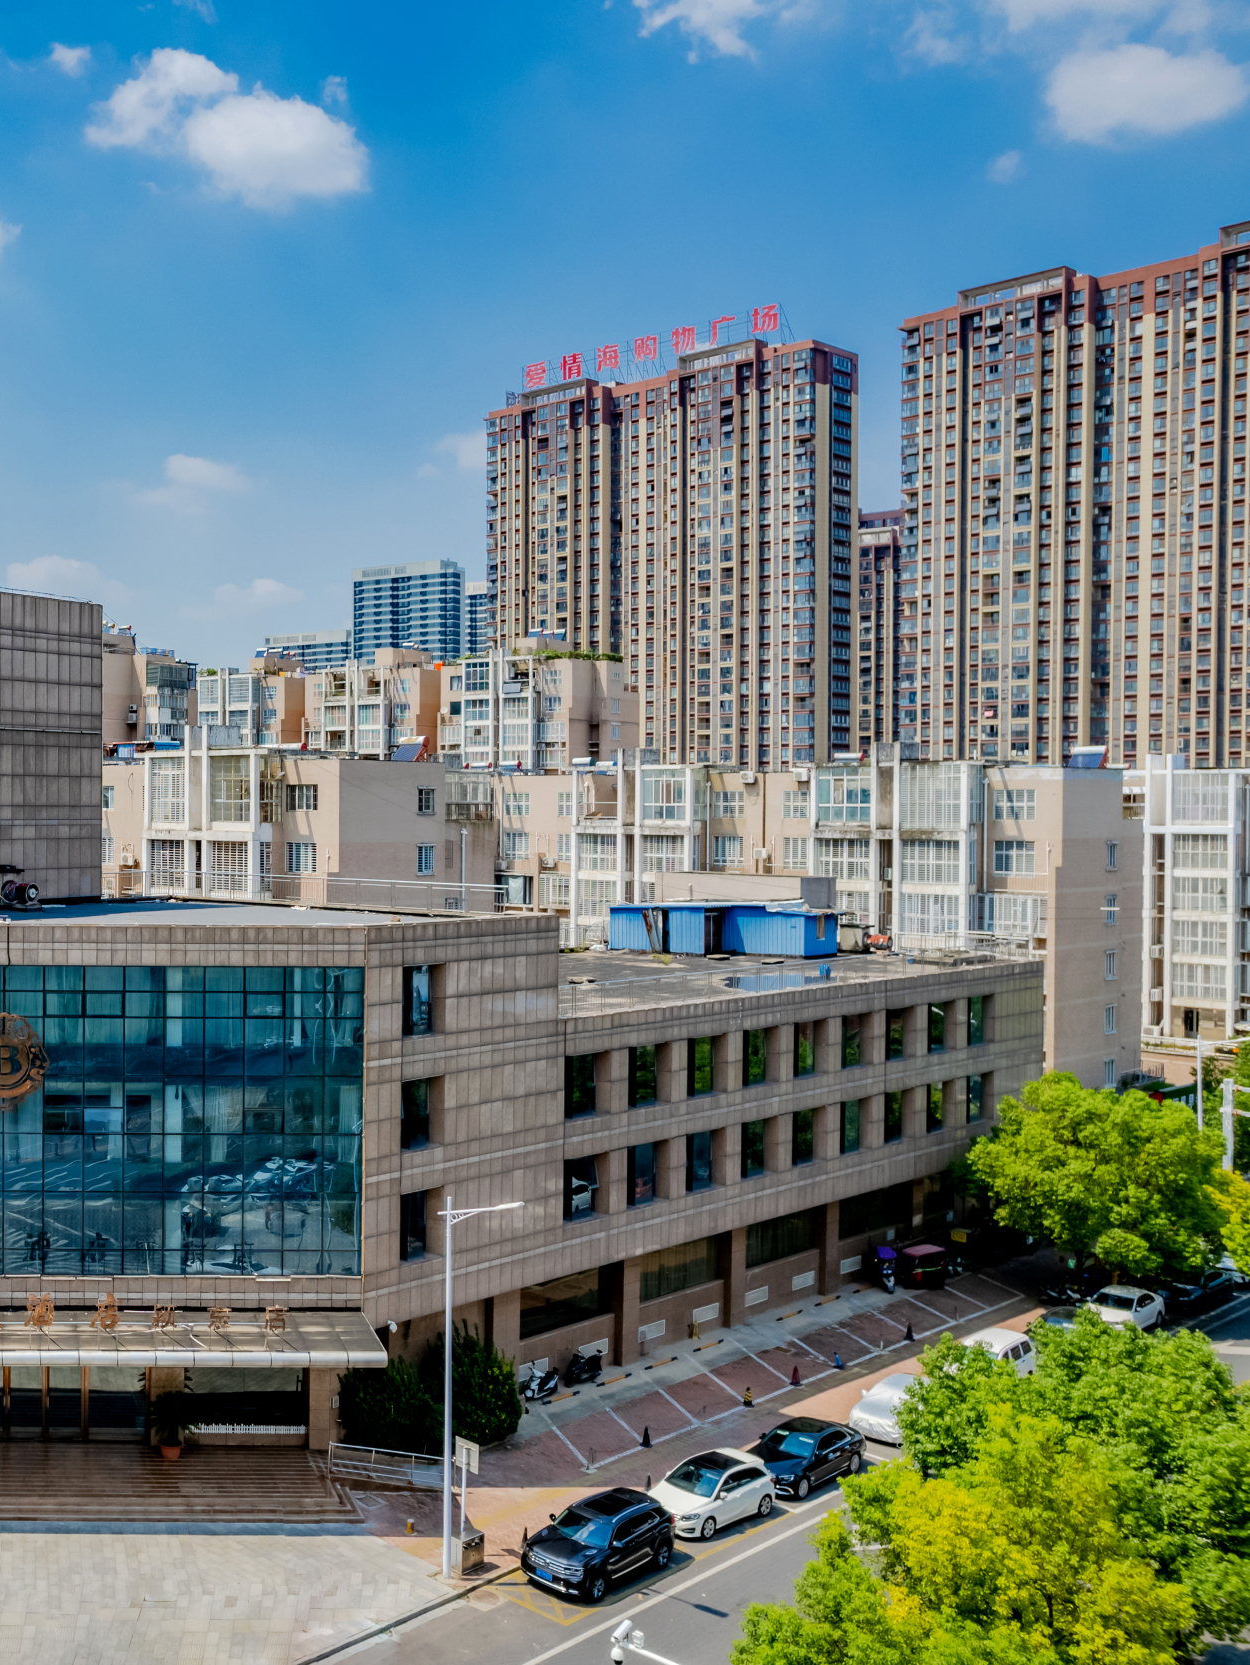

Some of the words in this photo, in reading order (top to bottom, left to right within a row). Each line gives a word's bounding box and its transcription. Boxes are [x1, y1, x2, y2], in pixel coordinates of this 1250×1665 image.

[525, 304, 779, 388] 爱情海购物广场
